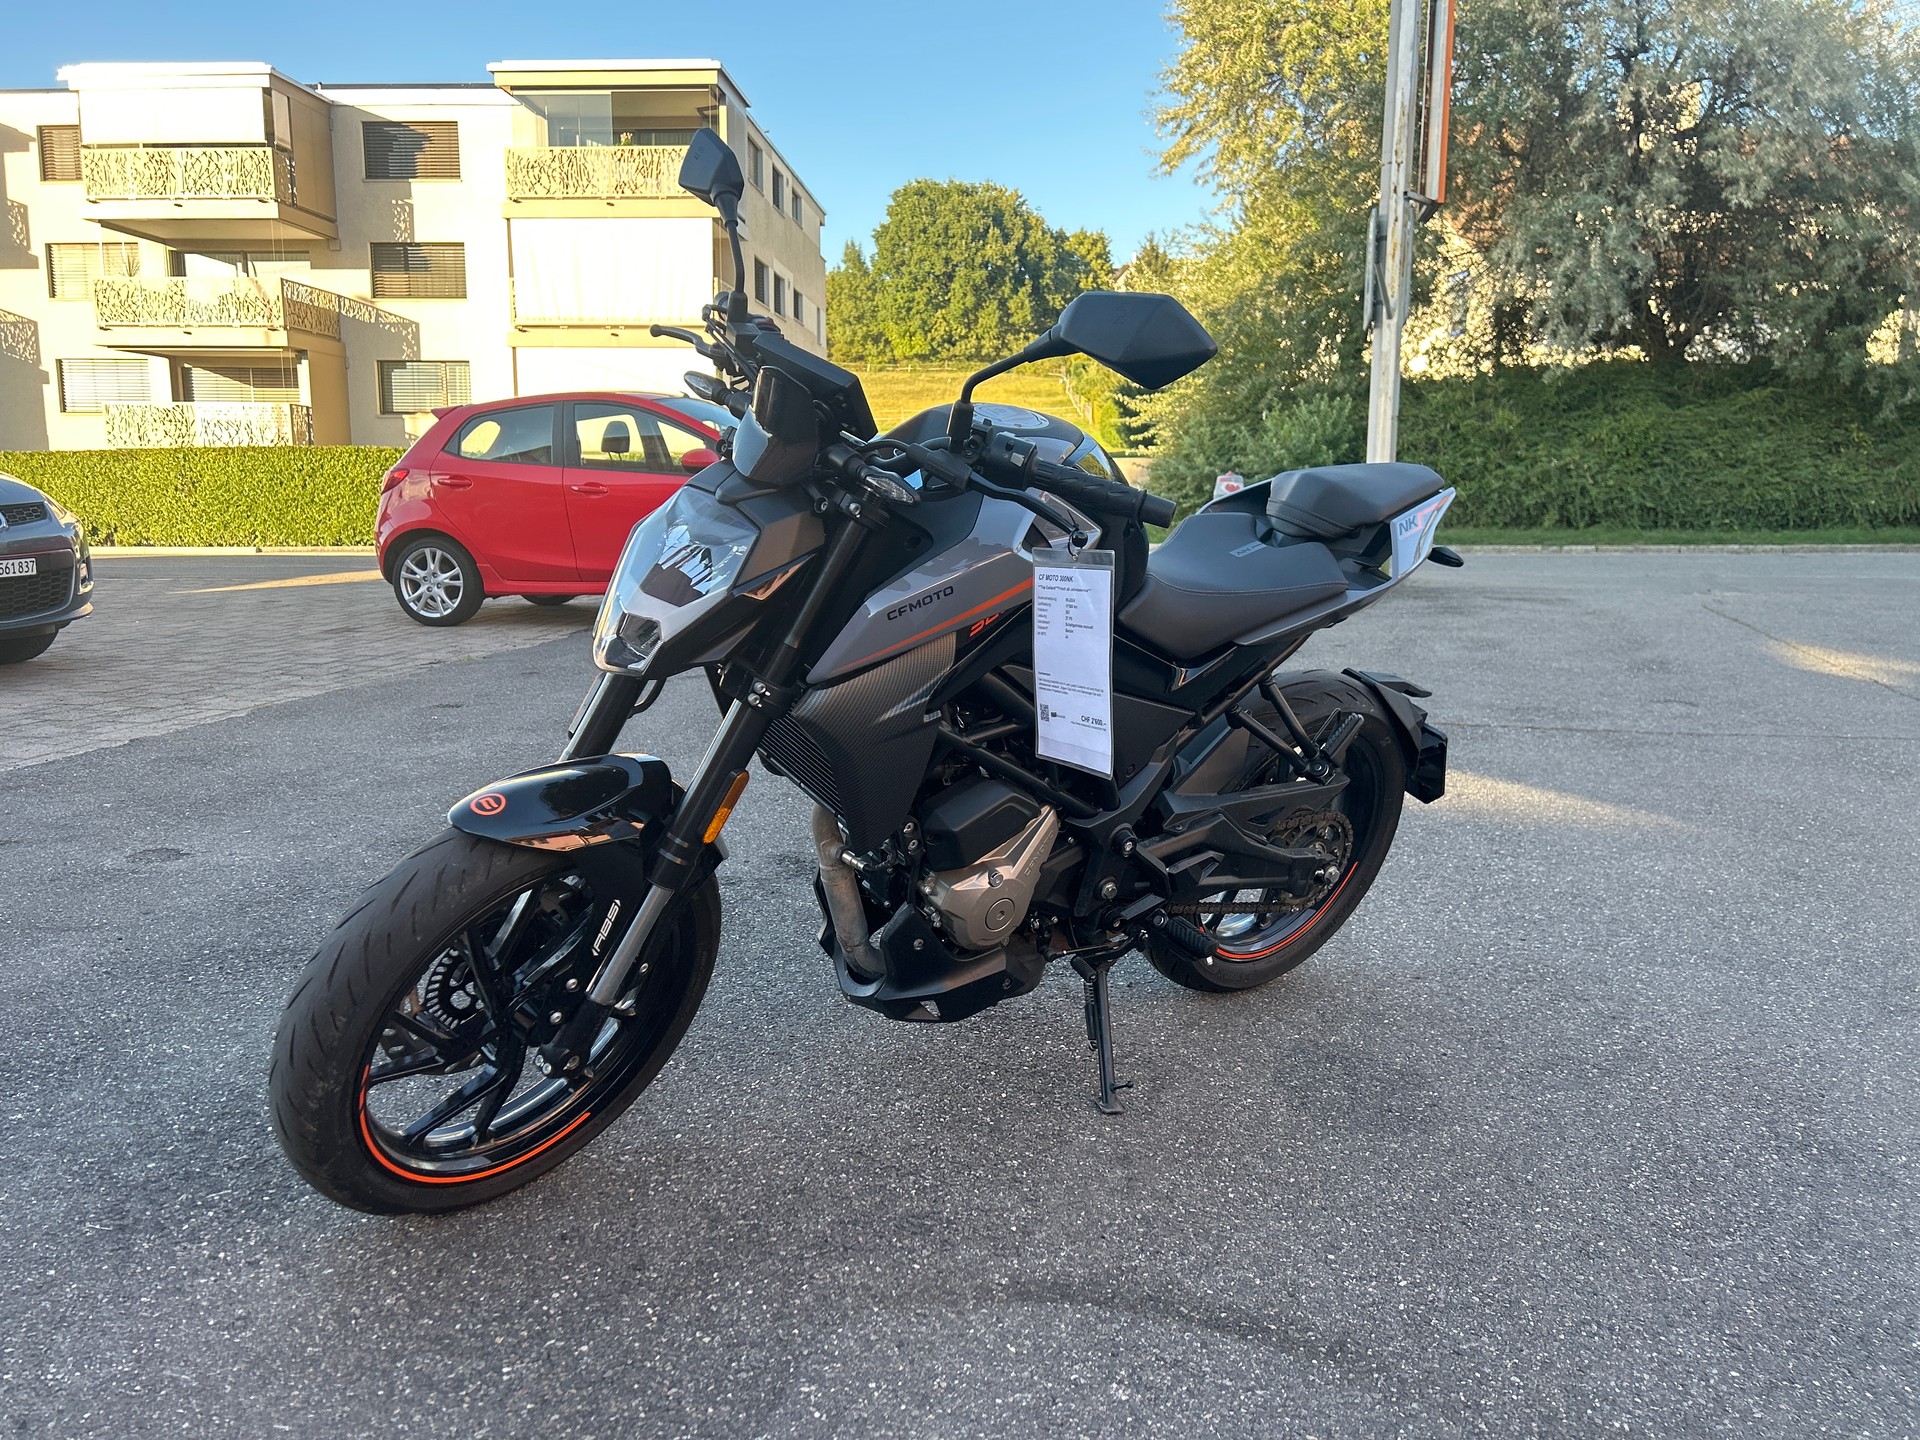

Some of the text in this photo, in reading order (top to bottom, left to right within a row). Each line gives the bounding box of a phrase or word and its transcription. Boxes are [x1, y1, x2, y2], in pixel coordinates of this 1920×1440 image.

[1399, 515, 1419, 536] NK
[1045, 574, 1059, 582] MOTO
[886, 585, 954, 621] CFMOTO
[1081, 715, 1090, 723] CHF
[593, 901, 620, 953] ABS
